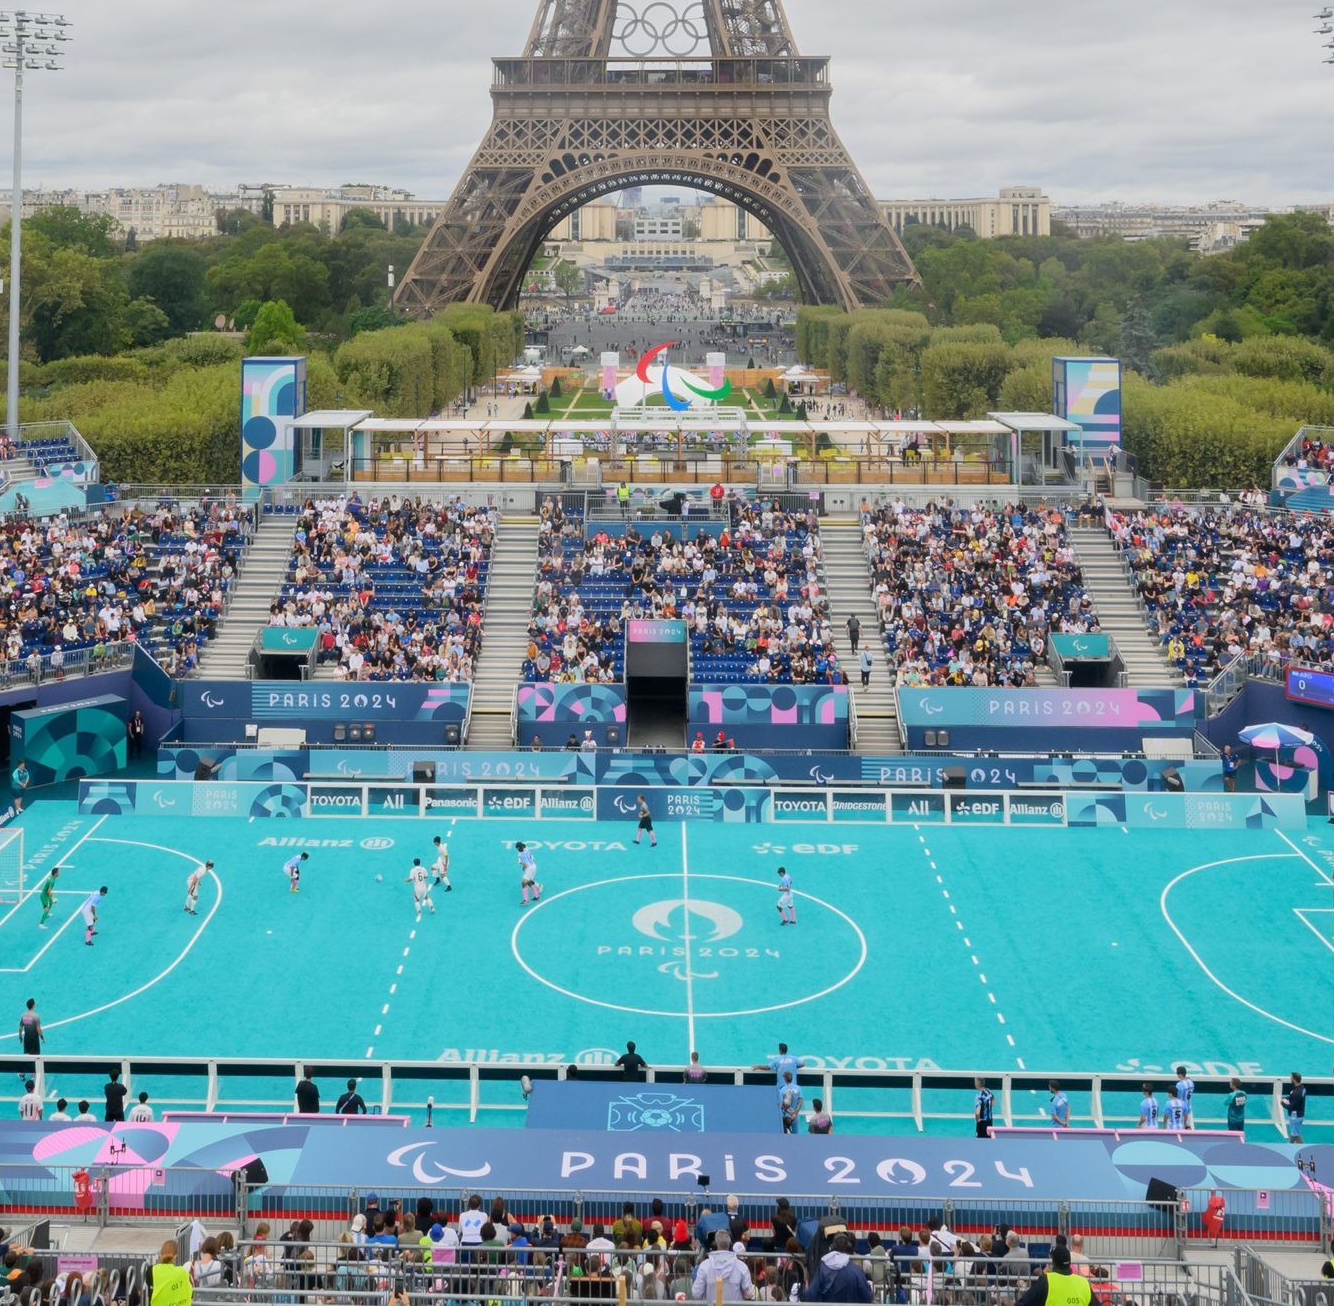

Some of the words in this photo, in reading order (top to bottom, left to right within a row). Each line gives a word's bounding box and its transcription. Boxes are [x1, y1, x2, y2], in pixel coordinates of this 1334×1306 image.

[1299, 680, 1305, 690] 0
[269, 694, 331, 708] PARIS
[340, 694, 396, 708] 2024
[989, 700, 1054, 715] PARIS
[1063, 701, 1120, 716] 2024
[407, 762, 471, 776] PRIS
[482, 762, 539, 776] 2024
[881, 767, 945, 782] PARIS
[205, 790, 237, 800] PARIS
[667, 795, 700, 804] PARIS
[205, 800, 237, 810] 2024
[311, 796, 361, 807] TOYOTA
[426, 797, 477, 808] Panasonic
[540, 797, 578, 809] Allianz
[775, 801, 827, 812] TOYOTA
[832, 801, 887, 811] BRIDGESTONE
[1198, 800, 1231, 811] PARIS
[667, 805, 701, 815] 2024
[1009, 803, 1048, 815] Allianz
[1198, 812, 1233, 822] 2024
[23, 844, 59, 870] PARIS
[51, 820, 83, 842] 2024
[257, 837, 353, 848] Allianz
[501, 840, 627, 851] TOYOTA
[418, 872, 423, 882] 6
[597, 946, 685, 956] PARIS
[699, 947, 779, 958] 2024
[435, 1048, 566, 1064] Allianz
[25, 1104, 33, 1116] 11
[1175, 1110, 1181, 1119] 5
[561, 1151, 788, 1184] PARIS
[823, 1156, 1035, 1188] 2024
